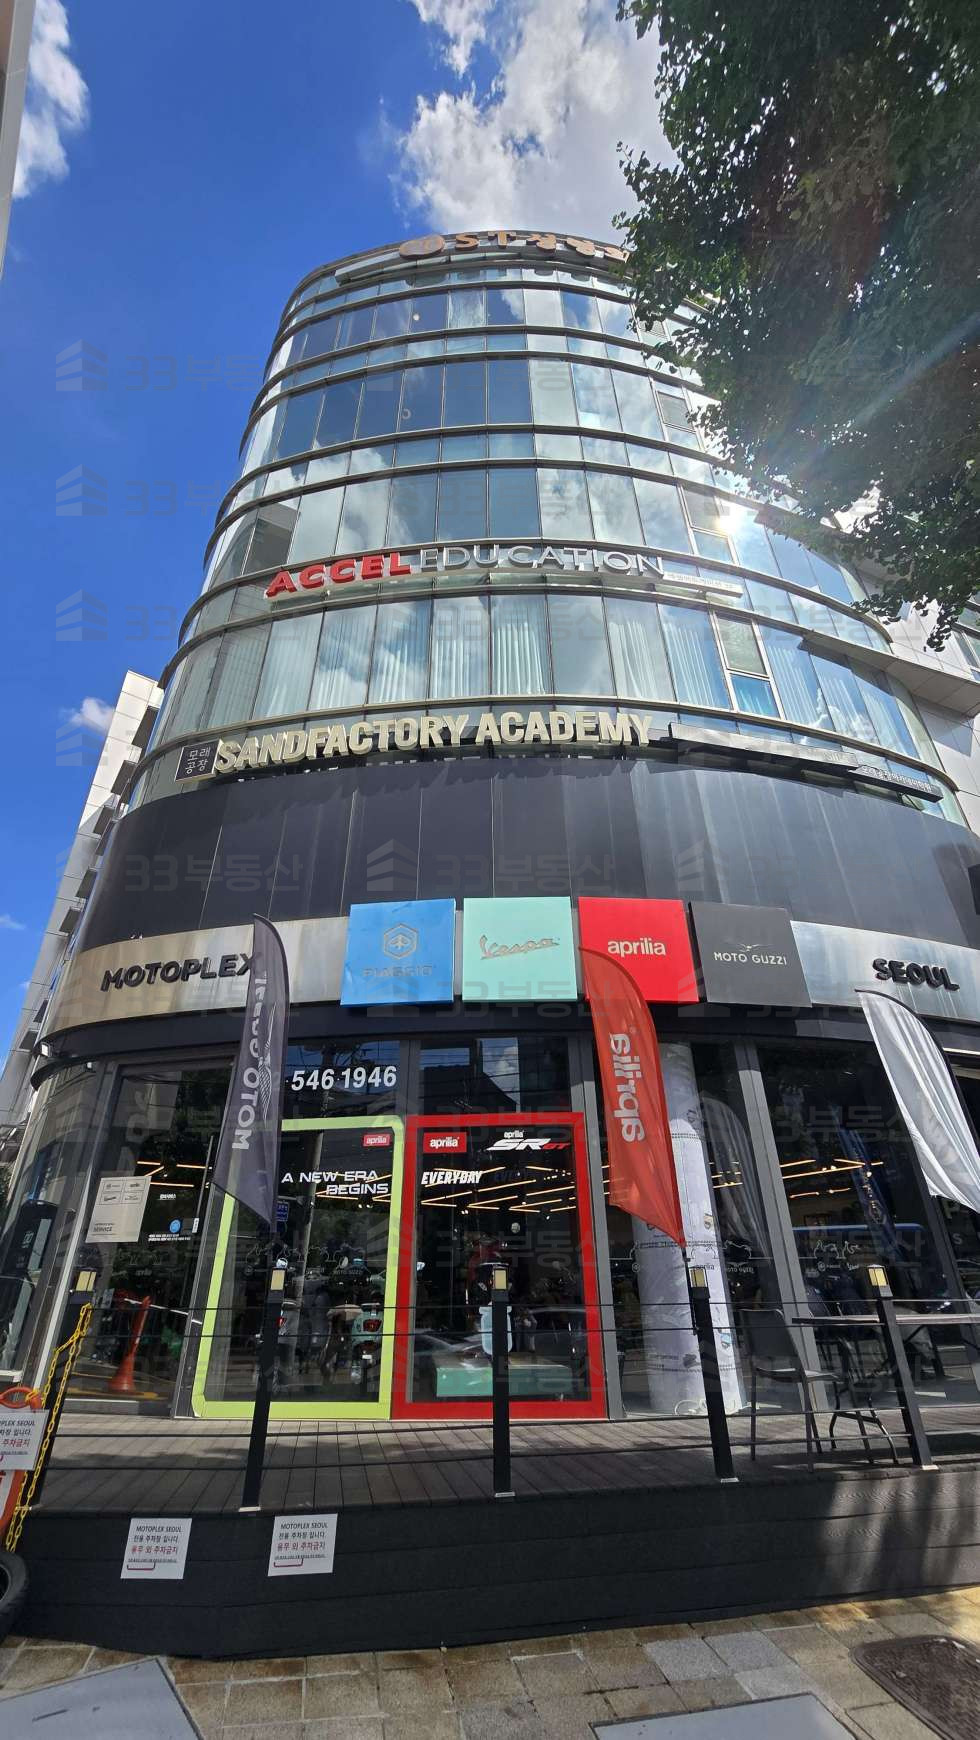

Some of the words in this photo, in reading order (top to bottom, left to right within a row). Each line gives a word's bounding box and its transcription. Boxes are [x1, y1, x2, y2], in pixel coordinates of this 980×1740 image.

[264, 552, 412, 599] ACCEL
[420, 543, 664, 579] EDUCATION
[216, 715, 469, 772] SANDFACTORY
[475, 711, 653, 747] ACADEMY
[187, 746, 211, 761] 모래
[185, 759, 208, 774] 공장
[479, 934, 560, 960] Vespa
[607, 938, 666, 957] aprilia
[714, 952, 747, 964] MOTO
[751, 954, 788, 966] GUZZI
[101, 953, 254, 993] MOTOPLEX
[872, 957, 960, 992] SEOUL
[503, 1131, 525, 1139] aprilia
[430, 1137, 459, 1149] aprilia
[281, 1172, 294, 1183] A
[299, 1171, 338, 1183] NEW
[344, 1170, 378, 1182] ERA
[421, 1170, 483, 1185] EVERYDAY
[326, 1183, 389, 1195] BEGINS
[136, 1525, 164, 1533] MOTOPLEX
